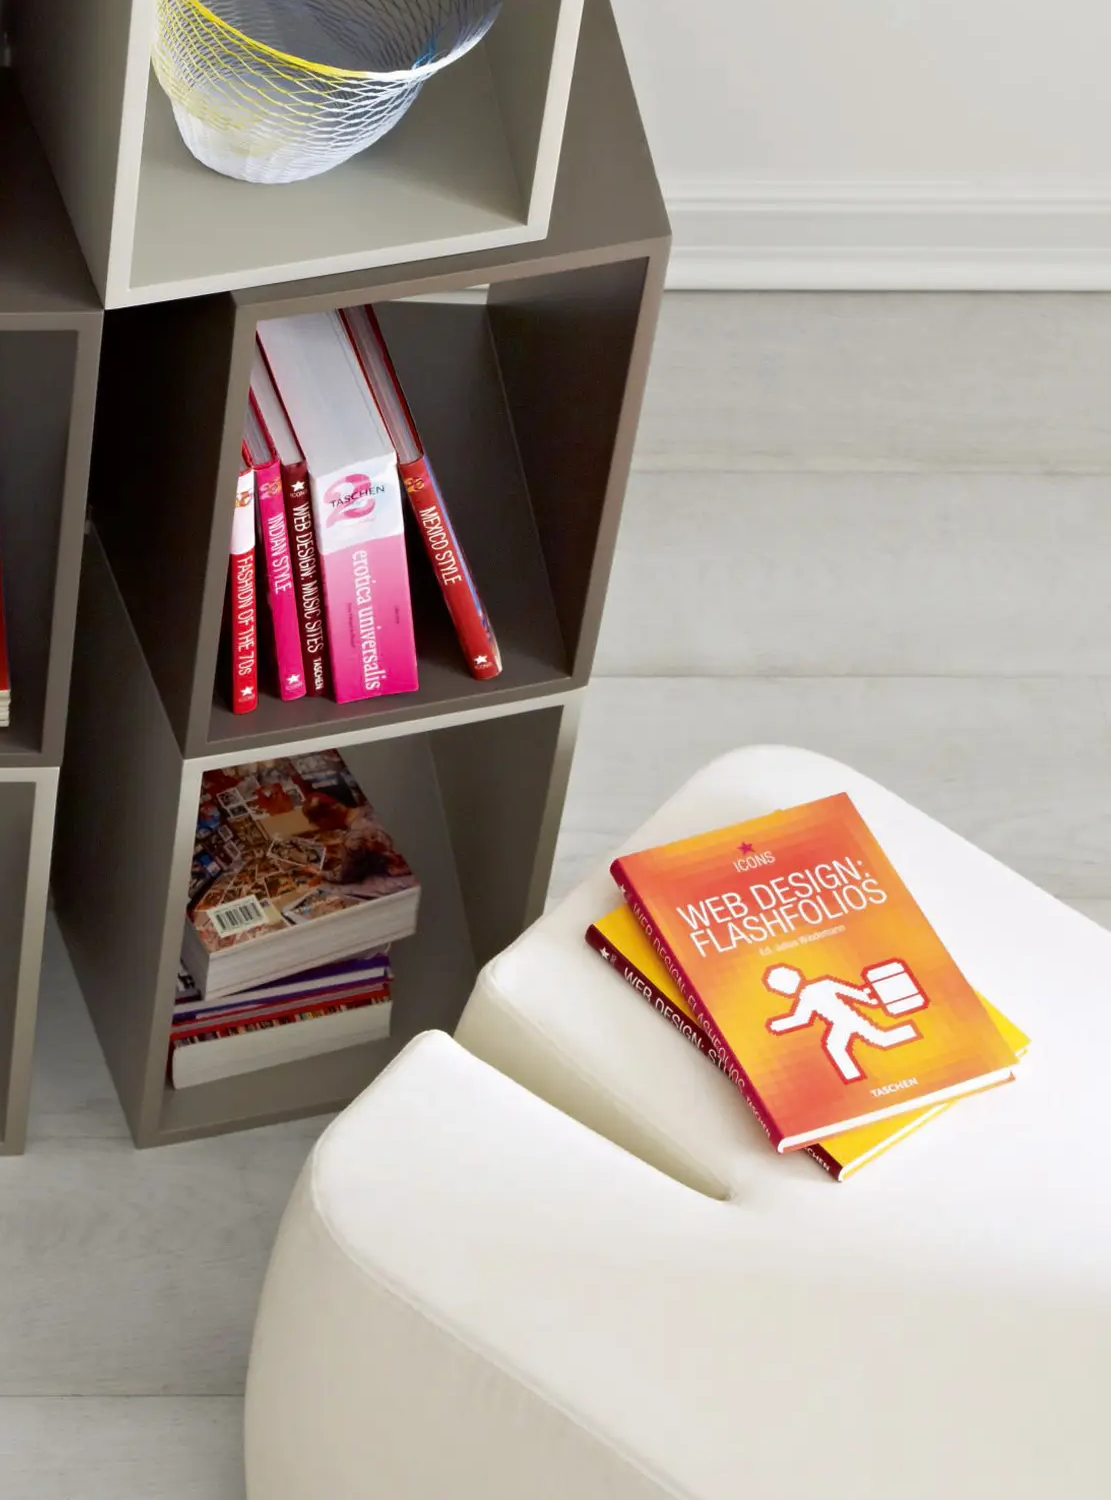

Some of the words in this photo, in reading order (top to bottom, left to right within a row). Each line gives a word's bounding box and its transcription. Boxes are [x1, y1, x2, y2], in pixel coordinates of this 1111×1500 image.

[292, 501, 310, 533] WEB
[330, 485, 386, 509] TASCHEN
[268, 512, 288, 557] INDIAN
[419, 505, 449, 551] MEXICO
[434, 549, 463, 586] STYLE
[272, 555, 292, 595] STYLE
[295, 532, 317, 580] DESIGN:
[237, 555, 254, 609] FASHION
[351, 550, 376, 606] erotica
[238, 608, 255, 626] OF
[301, 579, 321, 621] MUSIC
[238, 625, 255, 652] THE
[305, 620, 325, 654] SITES
[358, 605, 387, 692] universalis
[312, 657, 324, 691] TASCHEN
[732, 850, 777, 874] ICONS
[676, 891, 749, 931] WEB
[749, 856, 870, 911] DESIGN:
[688, 878, 888, 959] FLASHFOLIOS
[622, 966, 653, 1003] WEB
[869, 1077, 919, 1098] TASCHEN
